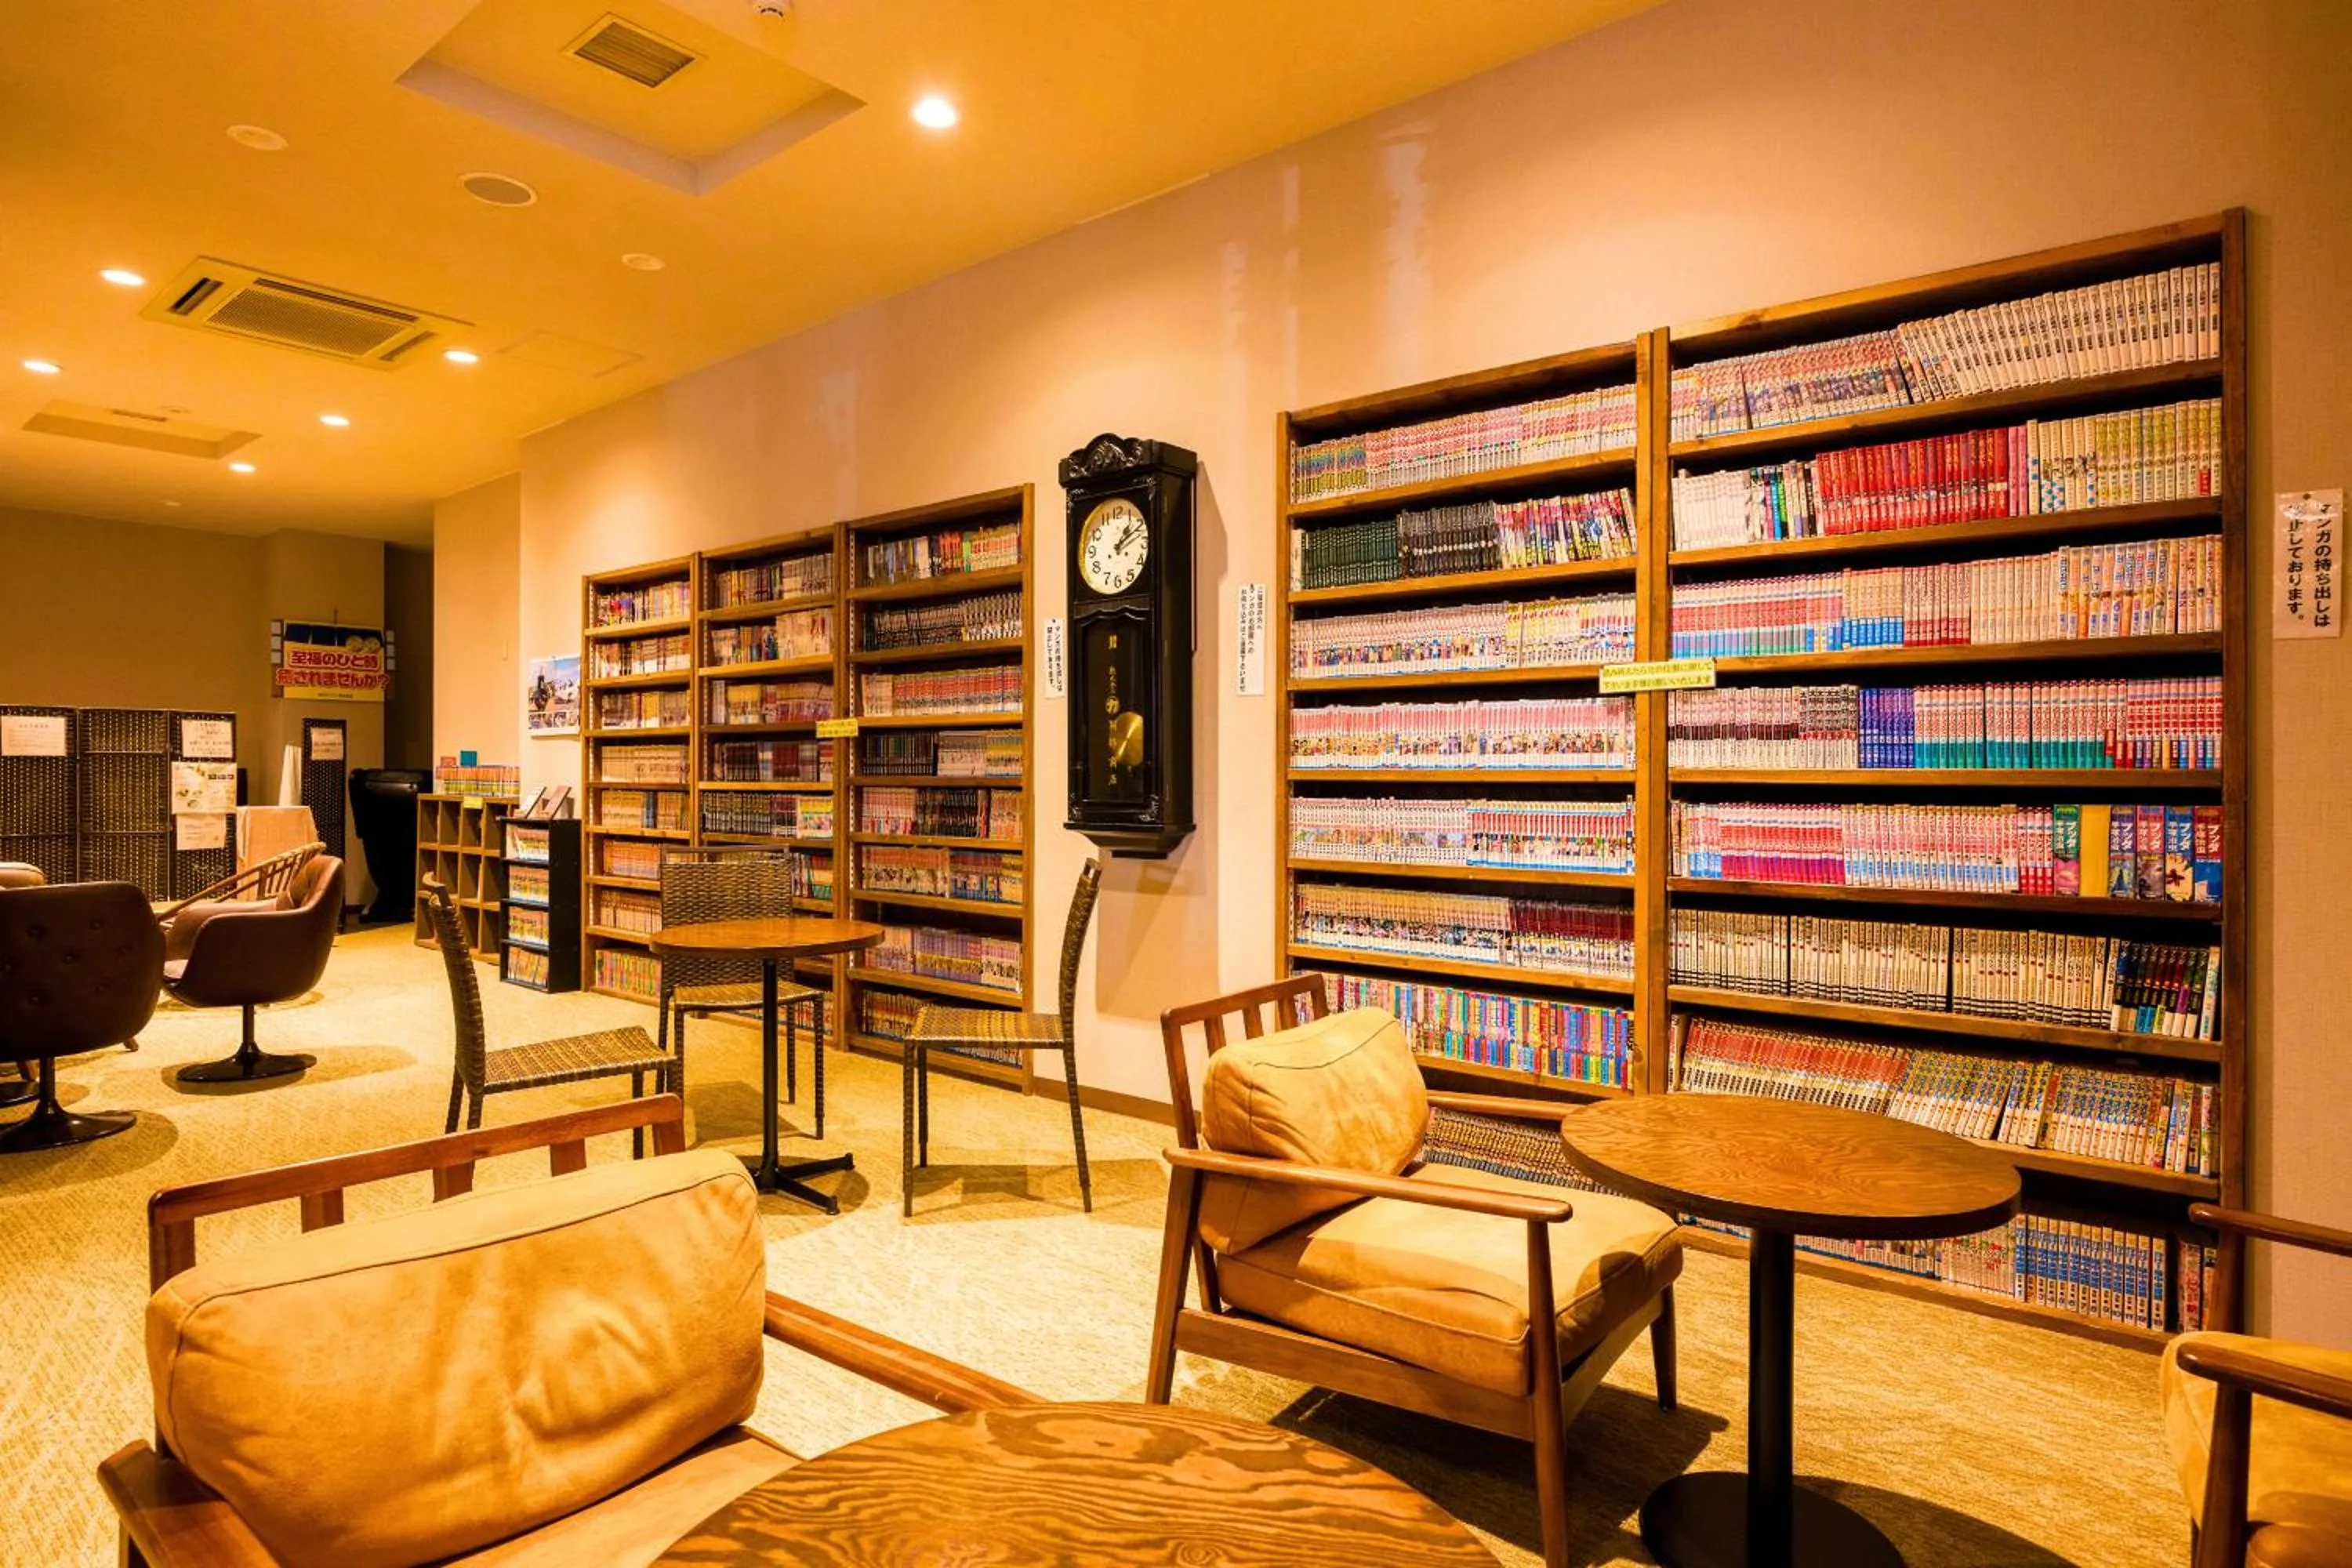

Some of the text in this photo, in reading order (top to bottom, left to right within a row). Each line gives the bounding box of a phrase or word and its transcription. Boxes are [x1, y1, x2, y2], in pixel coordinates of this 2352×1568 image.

[1102, 512, 1109, 525] 11
[1112, 506, 1123, 520] 12
[1092, 528, 1102, 541] 10
[1141, 536, 1148, 550] 3
[1088, 546, 1096, 558] 9
[1092, 561, 1101, 574] 8
[1135, 554, 1144, 568] 4
[2287, 504, 2304, 621] 止しております。
[2314, 504, 2332, 627] マンガの持ち出しは
[1104, 572, 1111, 585] 7
[1114, 575, 1122, 588] 6
[1126, 569, 1134, 582] 5
